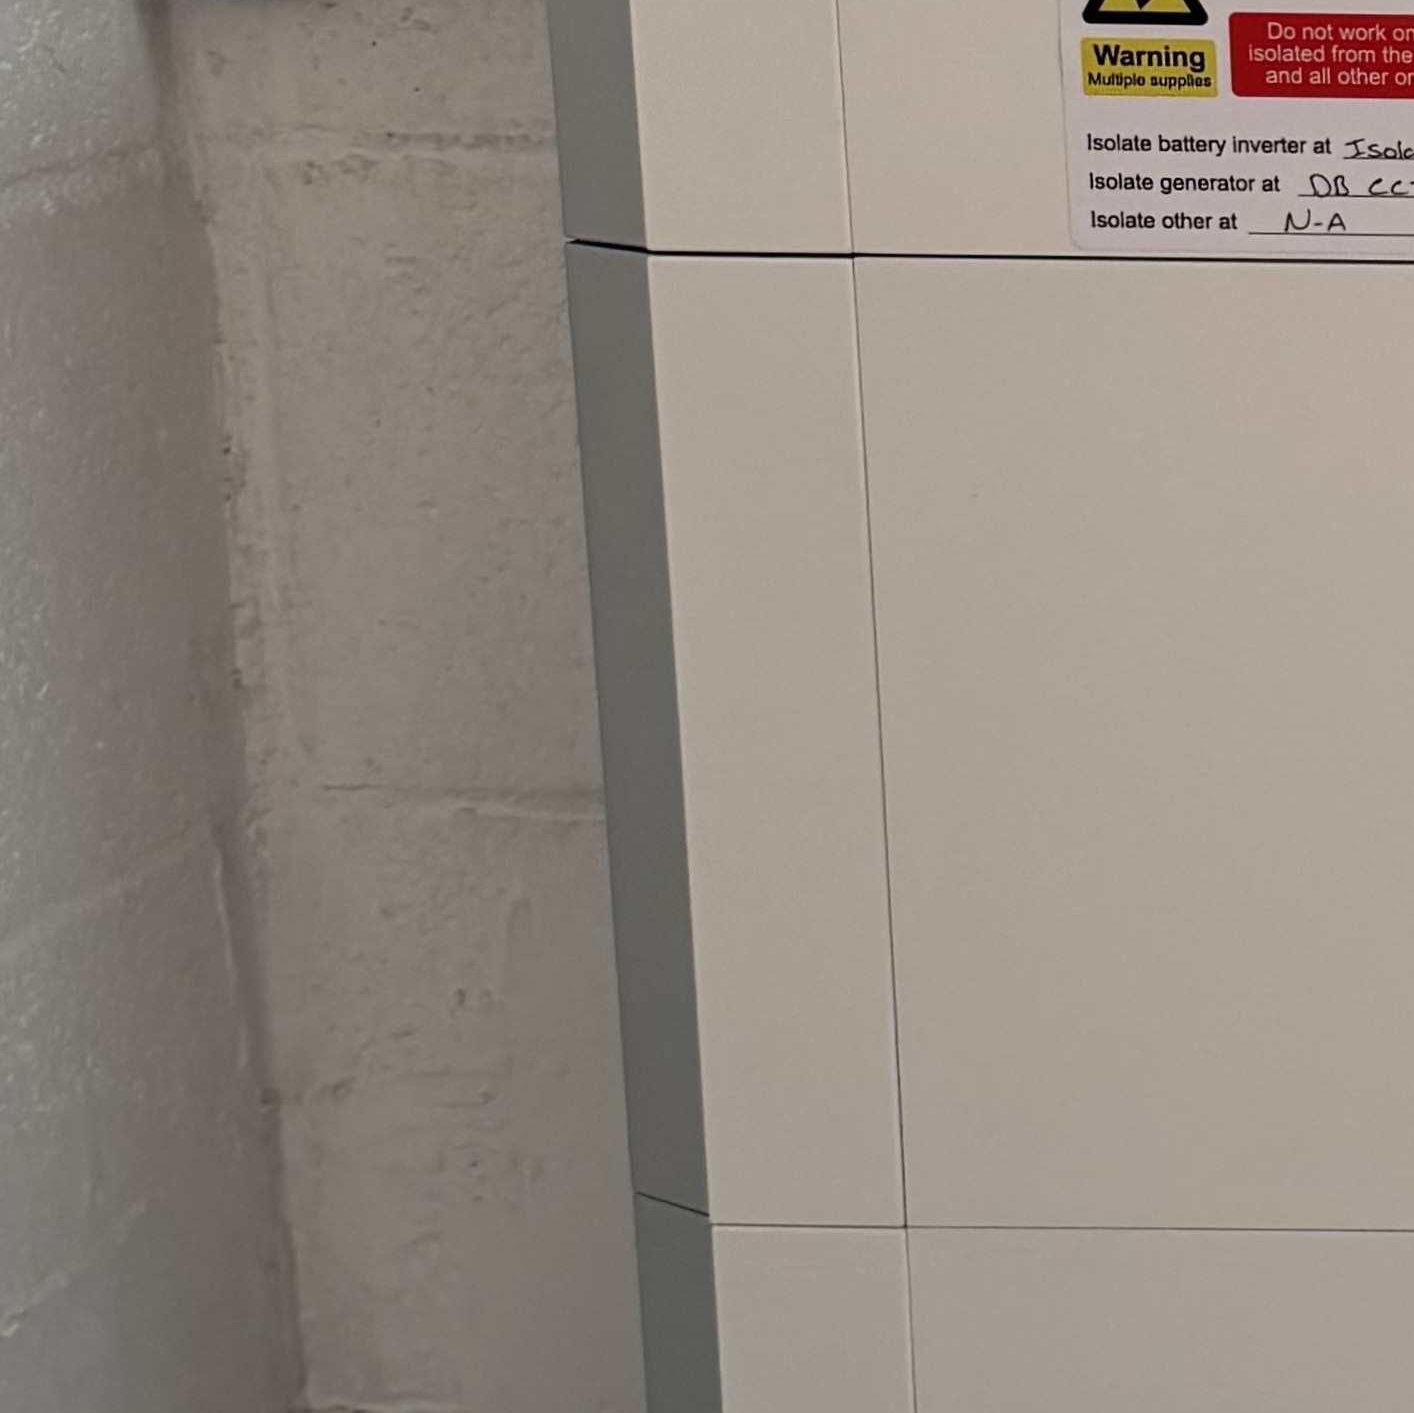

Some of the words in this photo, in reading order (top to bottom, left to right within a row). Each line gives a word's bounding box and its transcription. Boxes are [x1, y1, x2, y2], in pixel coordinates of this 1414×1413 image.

[1267, 22, 1296, 40] Do
[1302, 25, 1334, 40] not
[1339, 25, 1386, 42] work
[1093, 45, 1206, 70] Warning
[1248, 45, 1325, 62] isolated
[1331, 46, 1377, 63] from
[1383, 46, 1413, 64] the
[1087, 72, 1146, 90] Multiple
[1149, 74, 1212, 90] supplies
[1265, 68, 1302, 85] and
[1309, 68, 1332, 85] all
[1338, 68, 1389, 85] other
[1087, 134, 1151, 151] Isolate
[1158, 135, 1226, 156] battery
[1232, 137, 1306, 154] inverter
[1313, 138, 1331, 154] at
[1089, 173, 1153, 190] Isolate
[1160, 175, 1255, 194] generator
[1262, 177, 1279, 192] at
[1309, 174, 1349, 197] DB
[1091, 211, 1155, 228] Isolate
[1162, 213, 1212, 229] other
[1219, 214, 1237, 229] at
[1284, 209, 1346, 232] N-A
